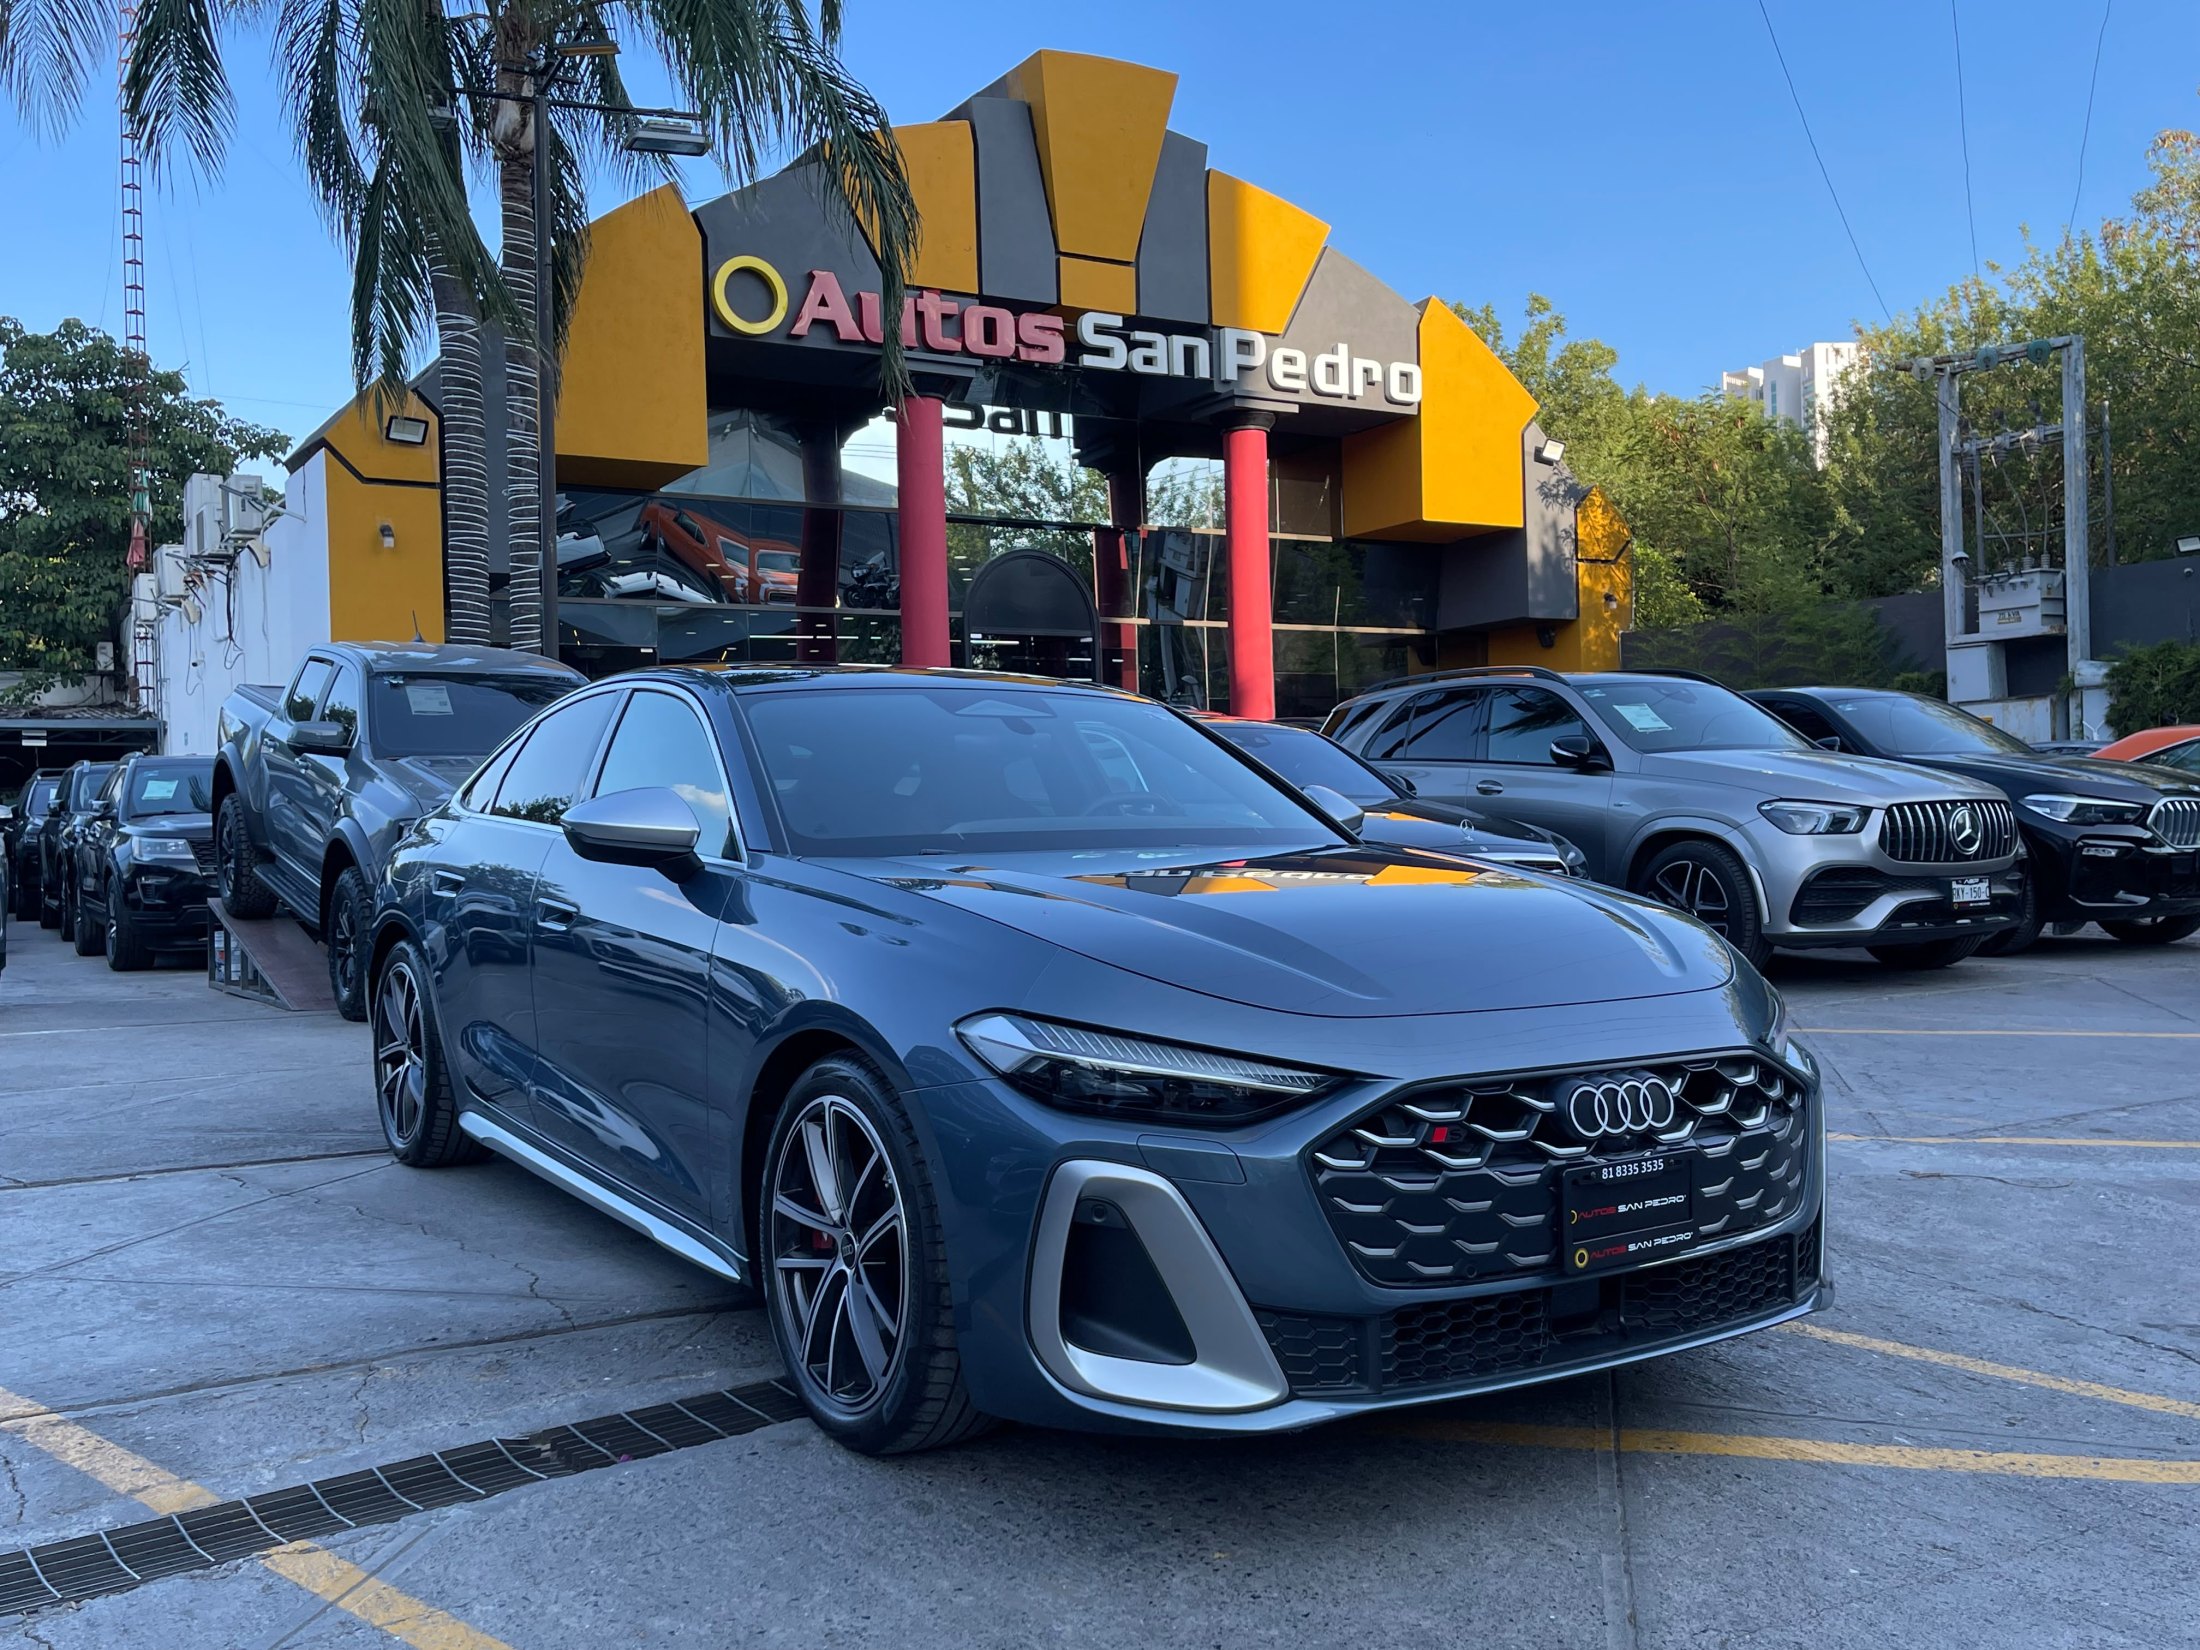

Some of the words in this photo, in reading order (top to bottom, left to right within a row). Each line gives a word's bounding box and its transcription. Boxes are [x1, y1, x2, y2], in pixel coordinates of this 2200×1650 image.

[790, 269, 1065, 364] Autos
[1077, 312, 1211, 379] San
[1220, 327, 1423, 405] Pedro
[1601, 1168, 1614, 1180] 81
[1615, 1163, 1639, 1178] 8335
[1641, 1158, 1664, 1174] 3535
[1577, 1206, 1617, 1219] AUTOS
[1617, 1201, 1643, 1213] SAN
[1644, 1194, 1685, 1208] PEDRO
[1590, 1245, 1627, 1259] AUTOS
[1627, 1240, 1652, 1252] SAN
[1653, 1232, 1692, 1246] PEDRO
